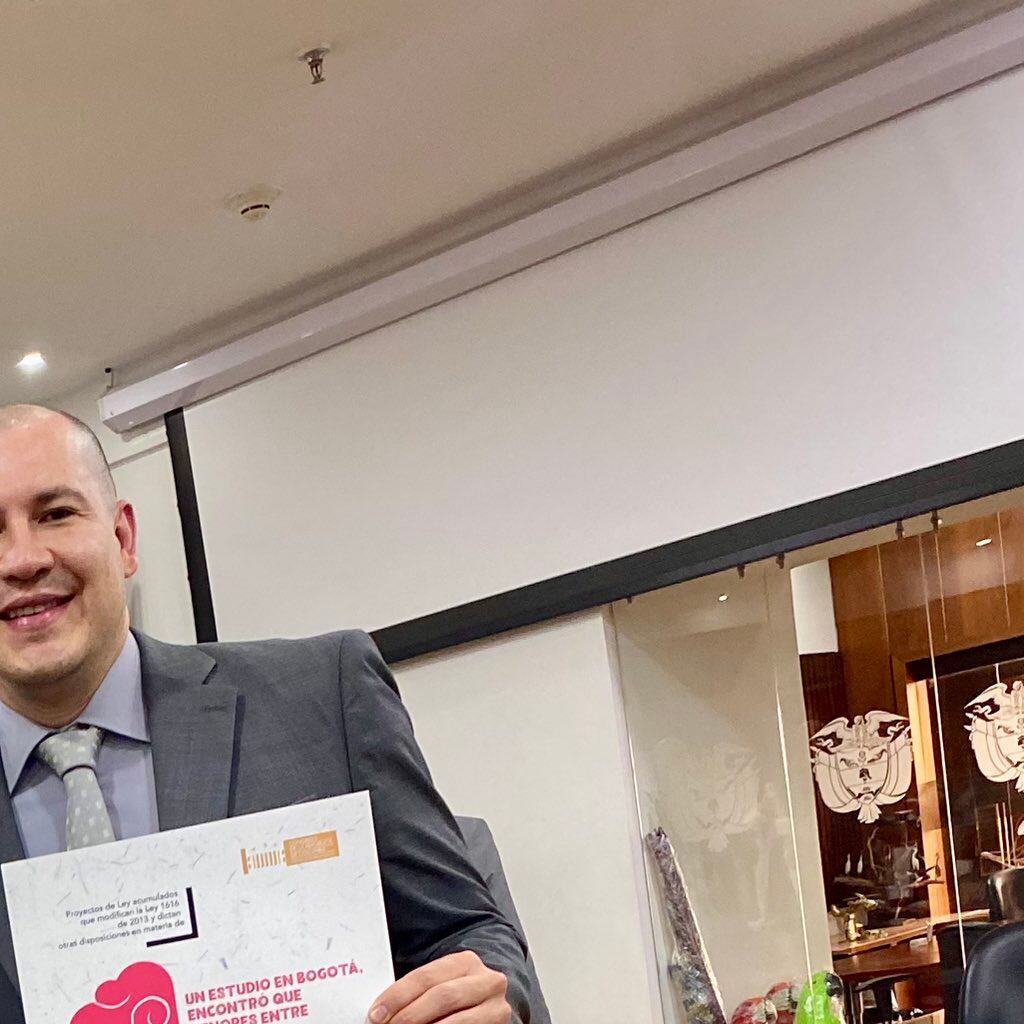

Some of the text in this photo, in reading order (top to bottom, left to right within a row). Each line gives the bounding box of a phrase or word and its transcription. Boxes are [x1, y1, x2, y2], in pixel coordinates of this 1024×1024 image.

[66, 906, 103, 918] Proyectos
[105, 902, 115, 910] de
[133, 891, 178, 905] acumulados
[80, 918, 95, 926] que
[97, 910, 134, 922] modifican
[161, 901, 179, 909] 1616
[130, 915, 149, 926] 2013
[151, 916, 155, 924] y
[157, 911, 181, 920] dictan
[58, 939, 77, 949] otras
[79, 930, 130, 945] disposiciones
[143, 922, 172, 933] materia
[174, 919, 185, 927] de
[185, 962, 363, 1005] UN ESTUDIO EN BOGOTÁ,
[187, 989, 302, 1021] ENCONTRÓ QUE
[260, 1004, 308, 1024] ENTRE
